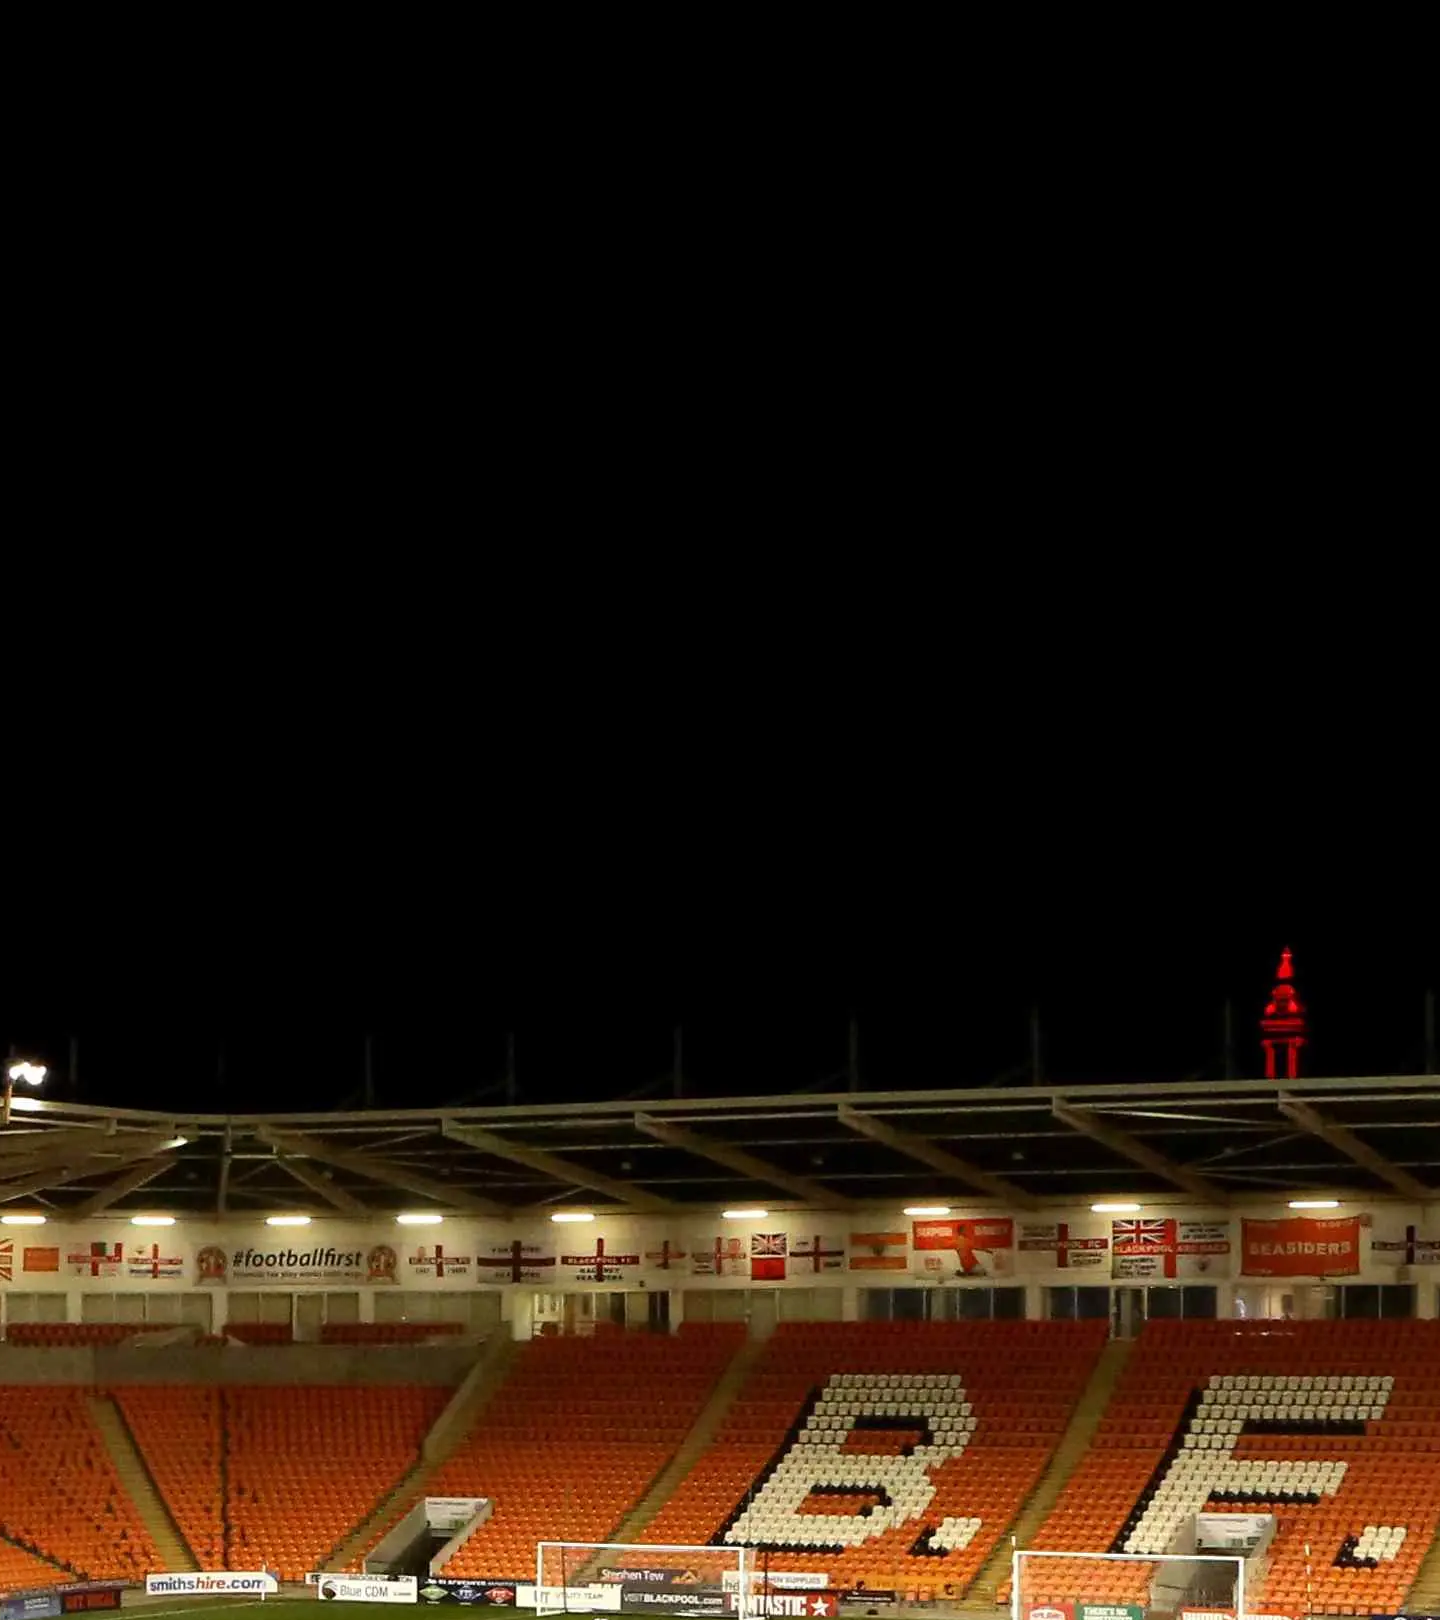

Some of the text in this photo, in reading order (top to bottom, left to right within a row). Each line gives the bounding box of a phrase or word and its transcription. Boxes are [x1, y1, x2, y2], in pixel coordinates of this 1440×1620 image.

[1249, 1241, 1352, 1256] SEASIDERS
[233, 1248, 363, 1268] #footballfirst
[644, 1571, 665, 1581] Tew
[149, 1576, 266, 1592] smithshire.com
[340, 1584, 389, 1598] Blue CDM
